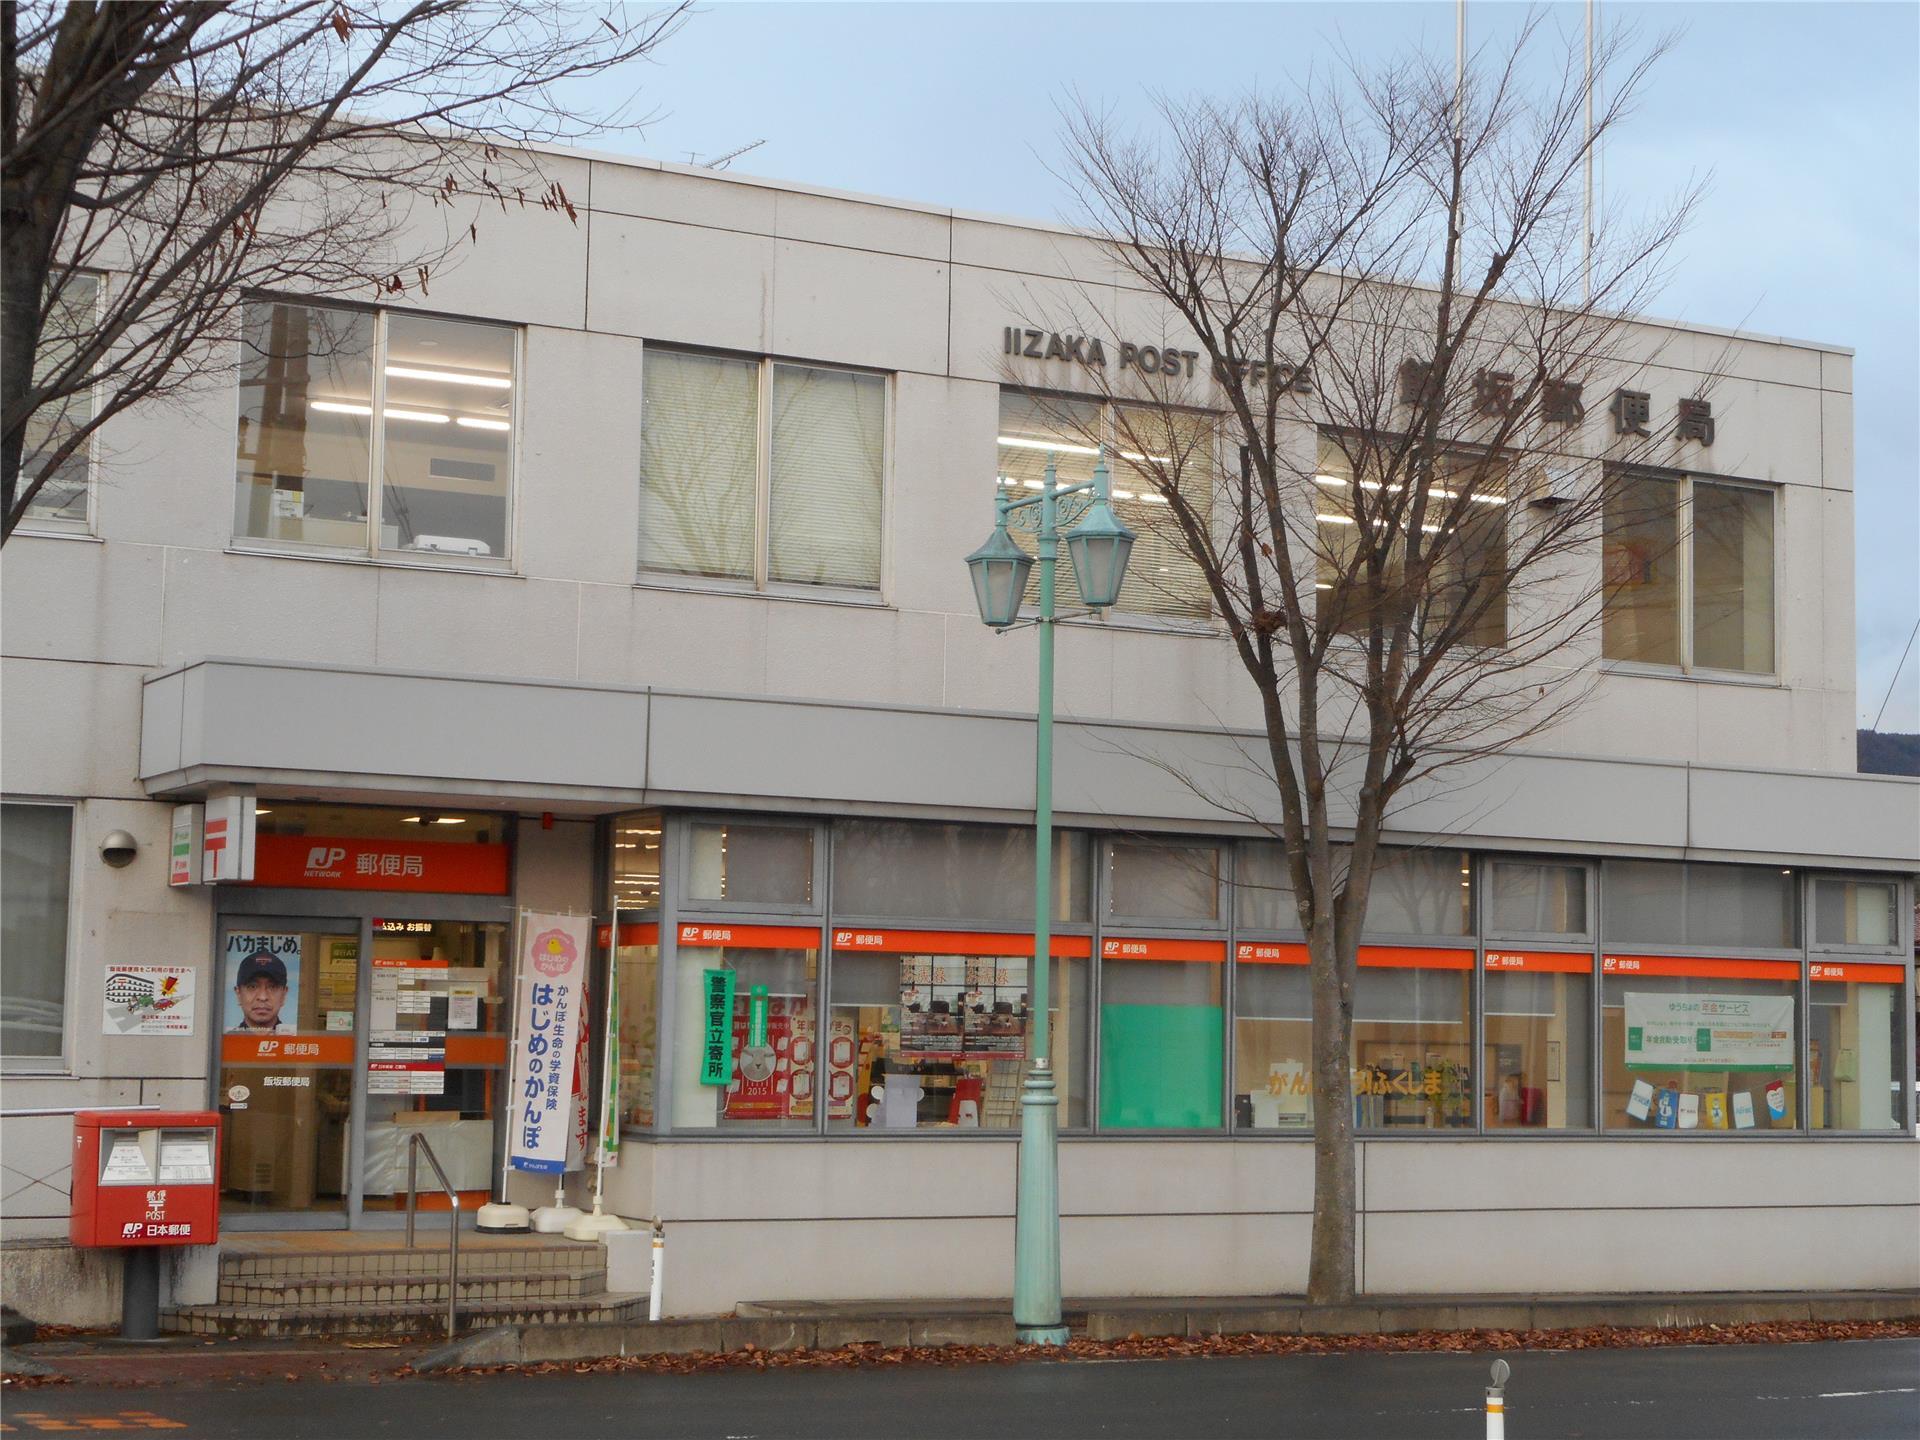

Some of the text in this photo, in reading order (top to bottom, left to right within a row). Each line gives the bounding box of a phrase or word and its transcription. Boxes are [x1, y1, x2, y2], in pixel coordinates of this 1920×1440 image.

[1004, 326, 1107, 367] IIZAKA
[1120, 341, 1199, 378] POST
[356, 853, 423, 877] 郵便局
[304, 870, 341, 878] NETWORK
[703, 930, 731, 940] 郵便局
[856, 935, 883, 945] 郵便局
[226, 935, 300, 955] バカまじめ。
[1122, 944, 1147, 954] 郵便局
[1256, 948, 1279, 958] 郵便局
[1502, 957, 1523, 966] 郵便局
[1619, 960, 1640, 969] 郵便局
[708, 975, 727, 1078] 警察官立寄所
[284, 1044, 319, 1055] 郵便局
[545, 984, 569, 1111] かんぽ生命の学資保険
[523, 982, 554, 1150] はじめのかんぽ
[264, 1076, 309, 1087] 飯坂郵便局
[748, 1087, 767, 1095] 2015
[146, 1190, 166, 1201] 郵便
[146, 1211, 165, 1220] POST
[147, 1224, 191, 1236] 日本郵便
